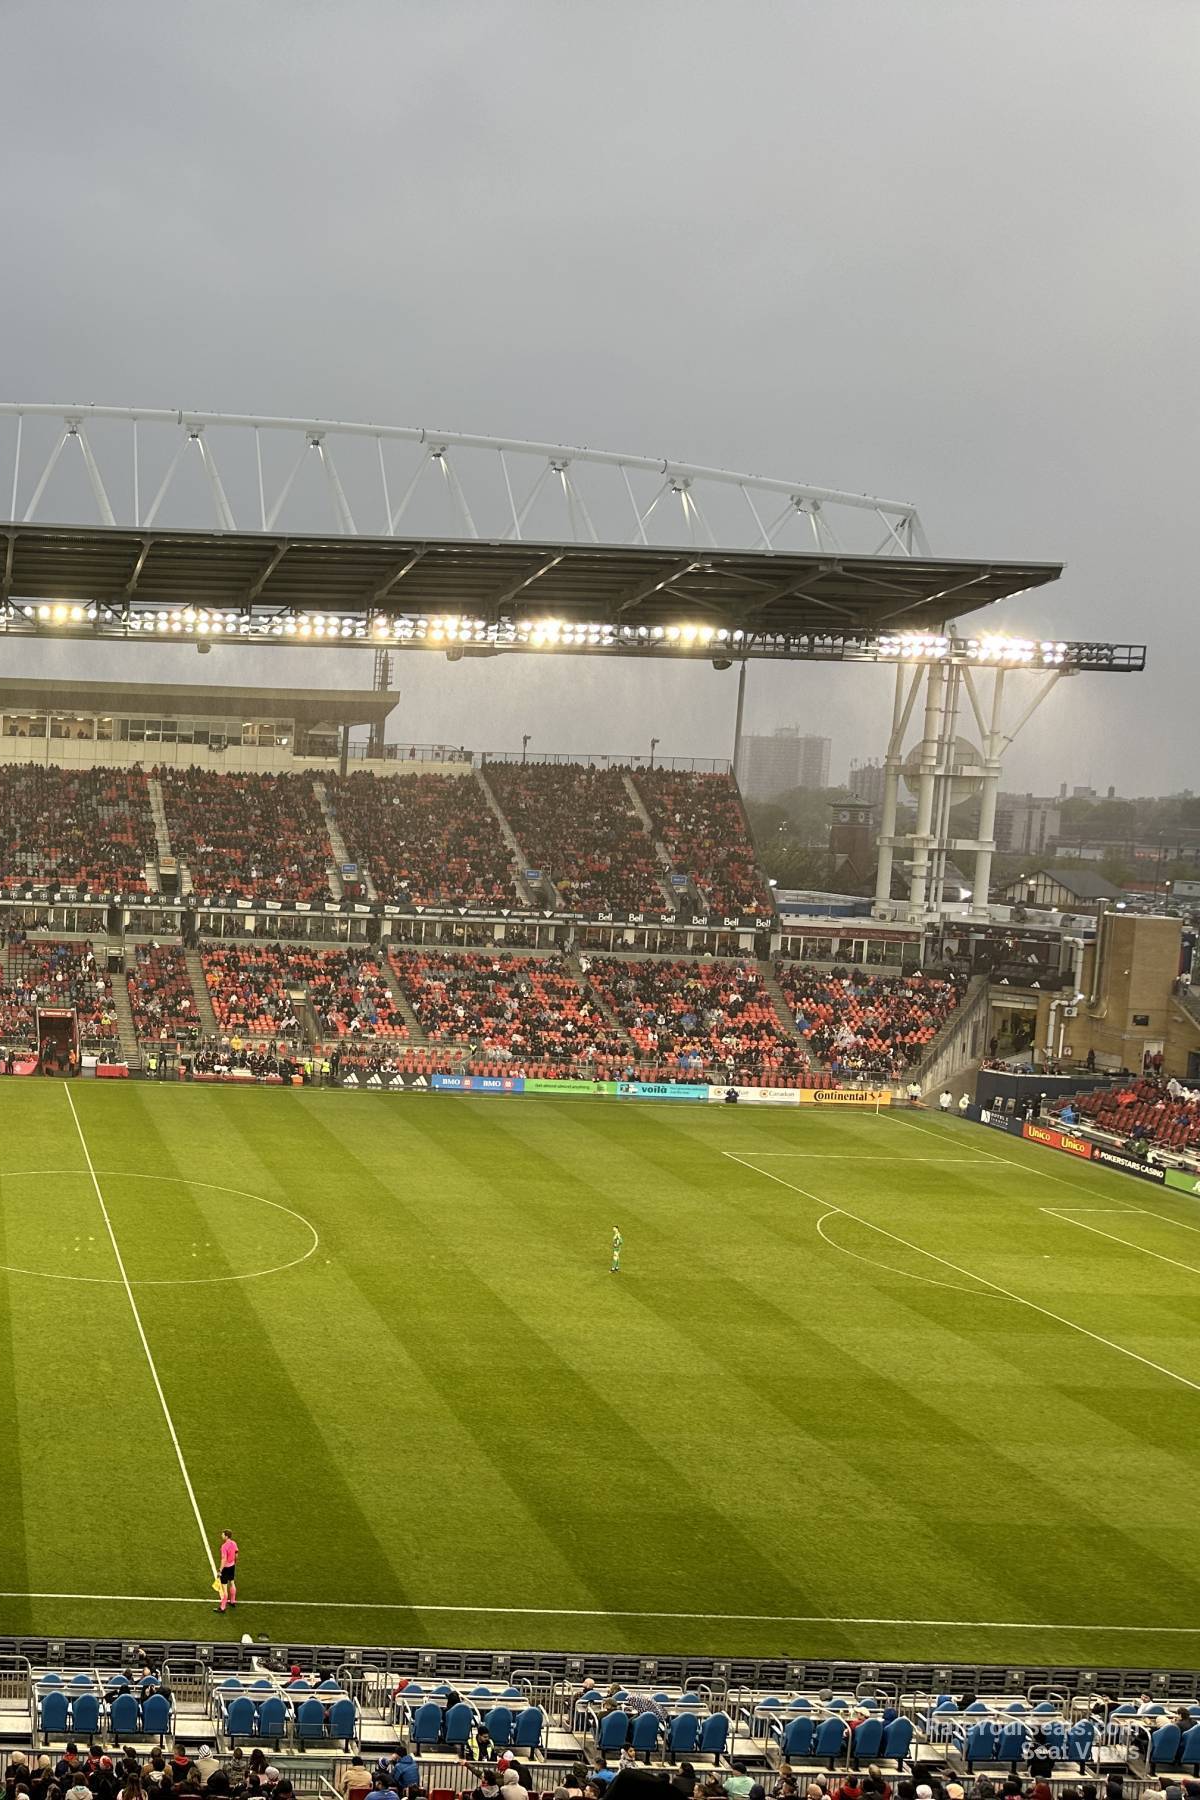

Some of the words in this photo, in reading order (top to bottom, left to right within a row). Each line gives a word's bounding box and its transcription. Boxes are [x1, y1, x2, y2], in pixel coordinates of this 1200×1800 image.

[598, 912, 613, 921] Bell
[628, 913, 644, 922] Bell
[660, 914, 676, 924] Bell
[692, 915, 708, 925] Bell
[723, 917, 739, 927] Bell
[755, 918, 771, 928] Bell
[442, 1078, 461, 1086] BMO
[483, 1080, 502, 1088] BMO
[641, 1085, 668, 1095] voilà
[813, 1090, 868, 1102] Continental
[1028, 1125, 1051, 1141] Unico
[1061, 1136, 1085, 1152] Unico
[1100, 1151, 1141, 1172] POKERSTARS
[1140, 1164, 1164, 1179] CASINO
